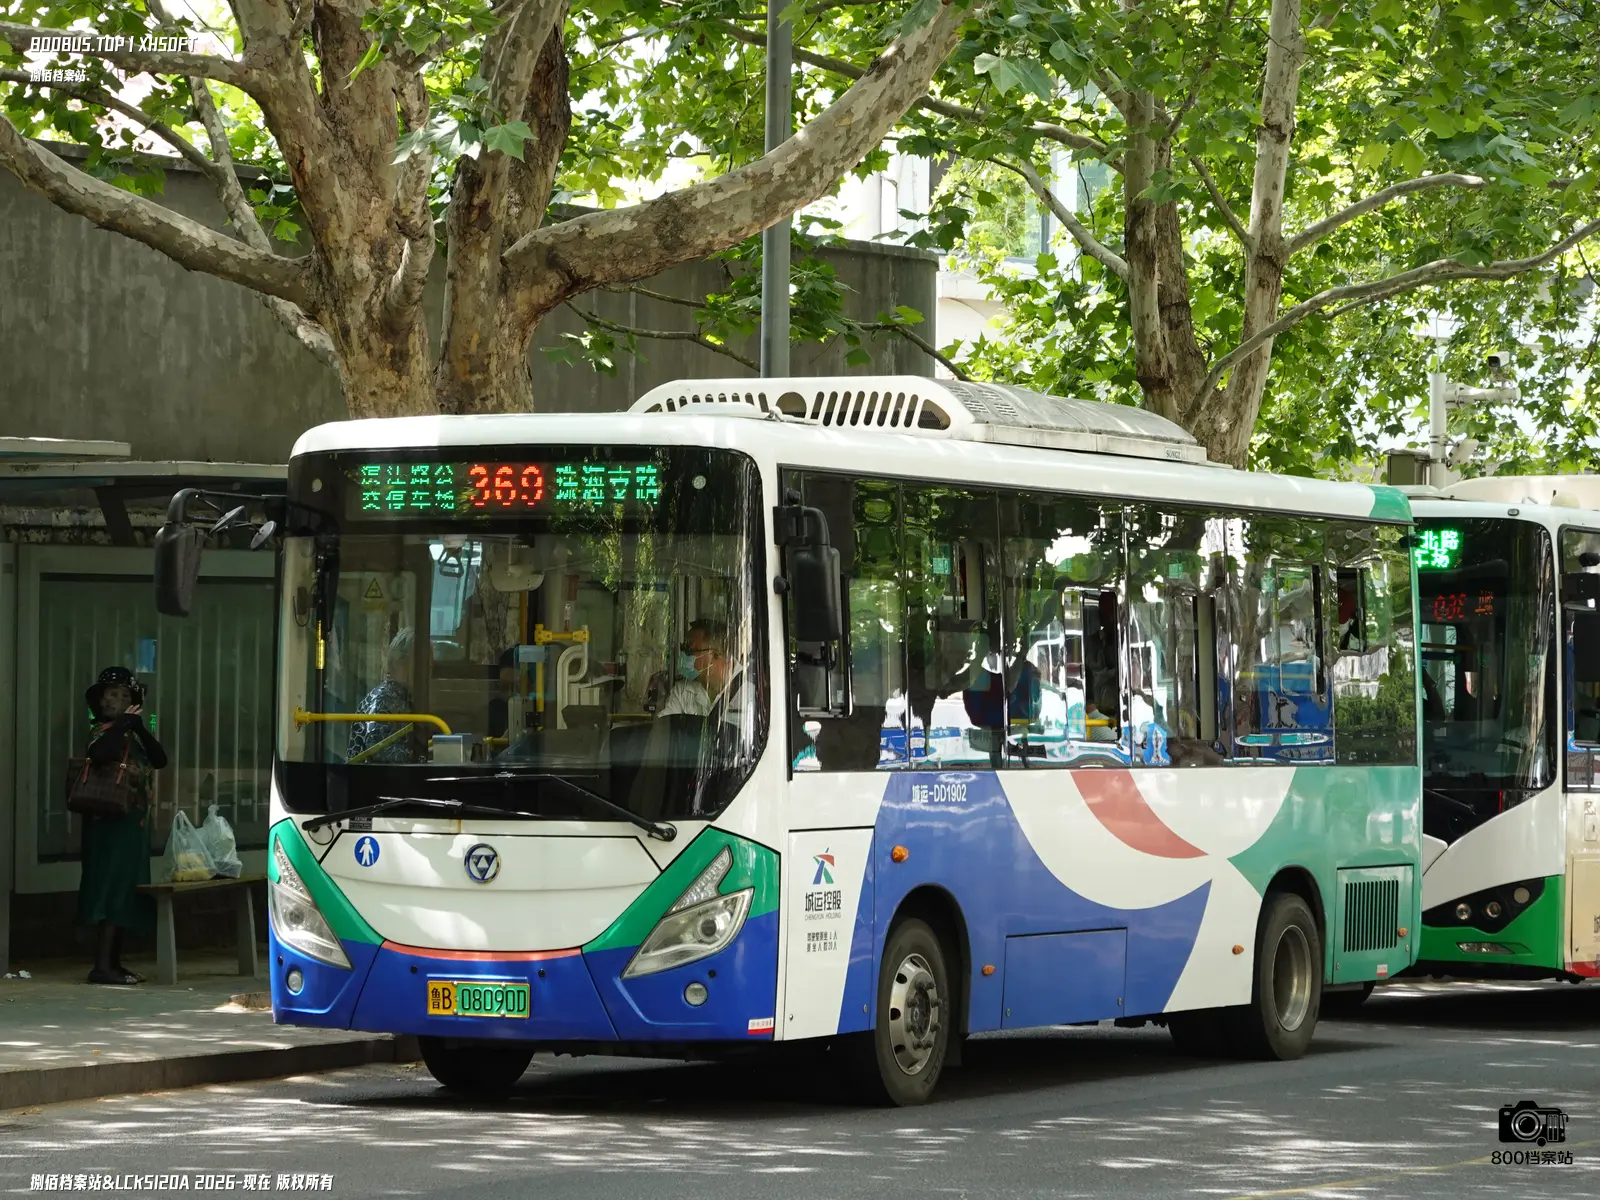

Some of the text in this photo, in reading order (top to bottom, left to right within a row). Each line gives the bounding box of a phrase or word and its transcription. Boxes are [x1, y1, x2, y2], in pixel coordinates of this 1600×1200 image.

[469, 465, 543, 506] 369
[805, 890, 841, 912] 城运控股
